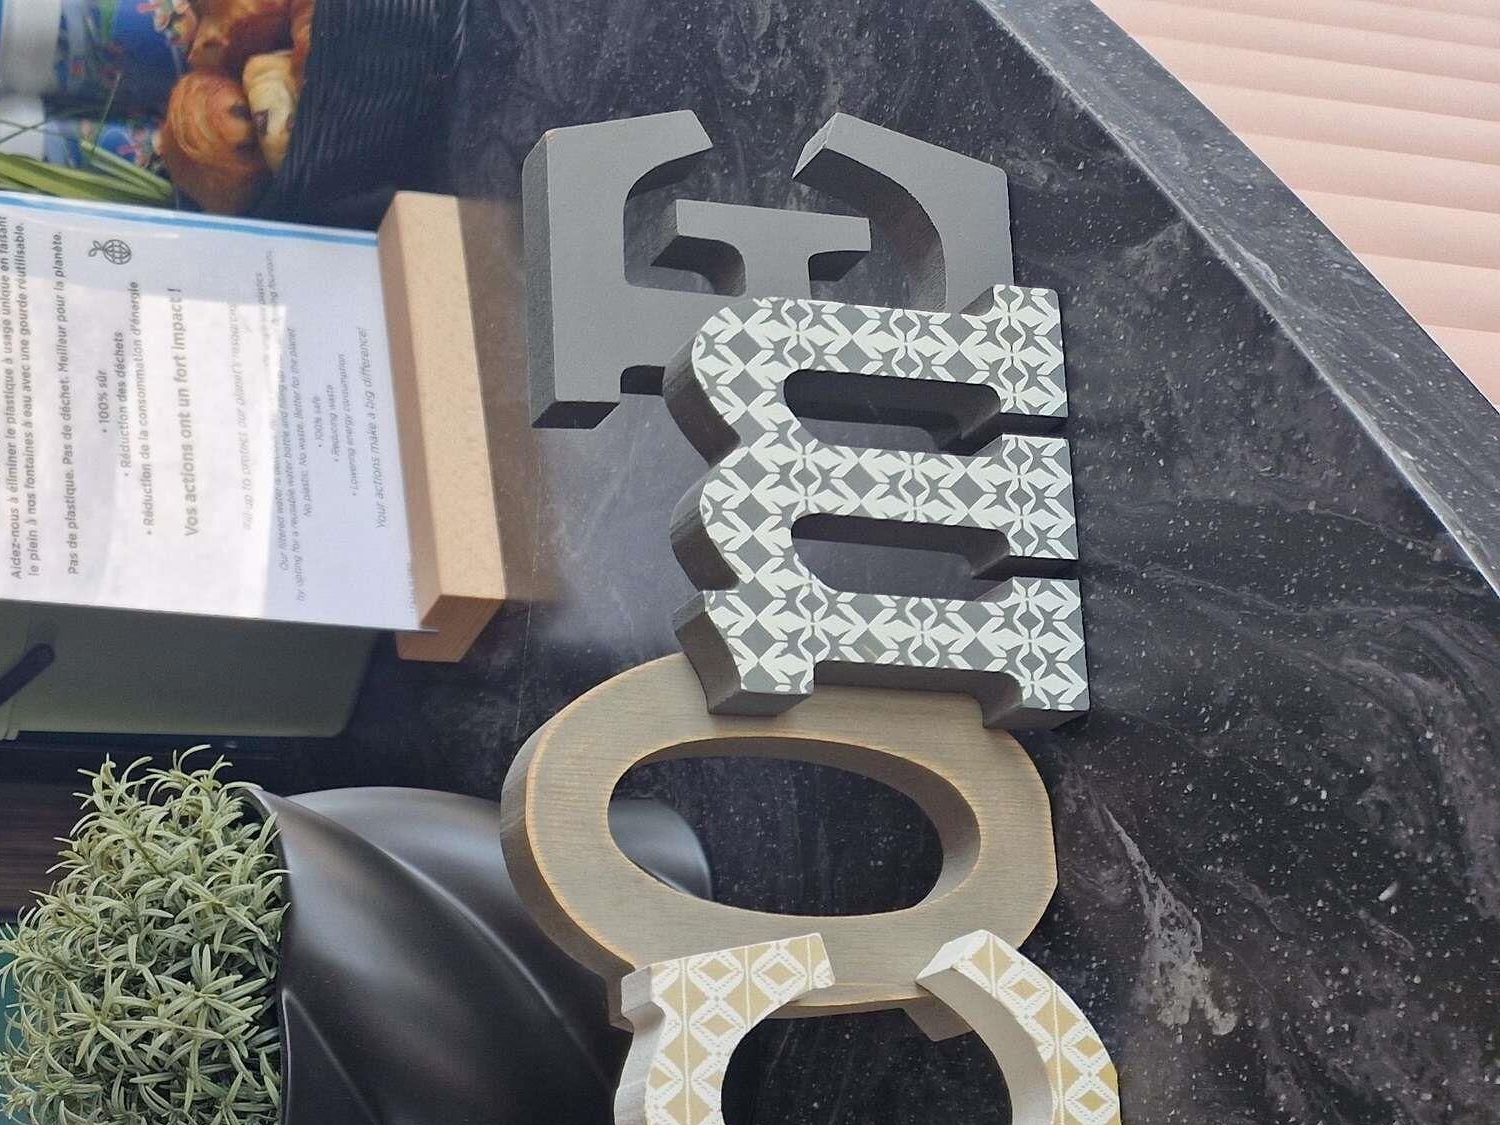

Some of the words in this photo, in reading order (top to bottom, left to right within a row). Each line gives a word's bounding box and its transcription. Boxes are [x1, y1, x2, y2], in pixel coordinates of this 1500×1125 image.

[0, 258, 9, 273] en
[13, 224, 26, 290] réutilisable.
[51, 232, 66, 280] planète.
[53, 281, 64, 292] la
[15, 293, 31, 336] gourde
[55, 295, 68, 323] pour
[127, 282, 141, 337] d'énergie
[1, 319, 13, 354] usage
[169, 297, 186, 353] impact
[19, 339, 29, 361] une
[55, 325, 68, 373] Meilleur
[113, 332, 126, 379] déchets
[20, 365, 32, 393] avec
[95, 370, 107, 389] sûr
[131, 339, 148, 427] consommation
[171, 356, 188, 385] fort
[2, 368, 17, 425] plastique
[58, 376, 71, 422] déchet.
[115, 381, 127, 403] des
[177, 389, 190, 409] un
[22, 395, 32, 418] eau
[97, 392, 110, 425] 100%
[3, 428, 16, 440] le
[20, 419, 33, 429] à
[60, 425, 72, 441] de
[115, 406, 131, 469] Réduction
[137, 430, 148, 441] la
[177, 413, 192, 441] ont
[22, 431, 36, 490] fontaines
[61, 444, 73, 466] Pas
[138, 444, 150, 460] de
[5, 442, 19, 493] éliminer
[179, 445, 197, 505] actions
[6, 497, 19, 505] à
[26, 493, 36, 515] nos
[63, 470, 78, 530] plastique.
[139, 463, 154, 527] Réduction
[24, 519, 37, 527] à
[184, 506, 199, 537] Vos
[9, 508, 22, 580] Aidez-nous
[25, 530, 40, 561] plein
[65, 533, 77, 549] de
[27, 565, 39, 577] le
[67, 553, 79, 575] Pas
